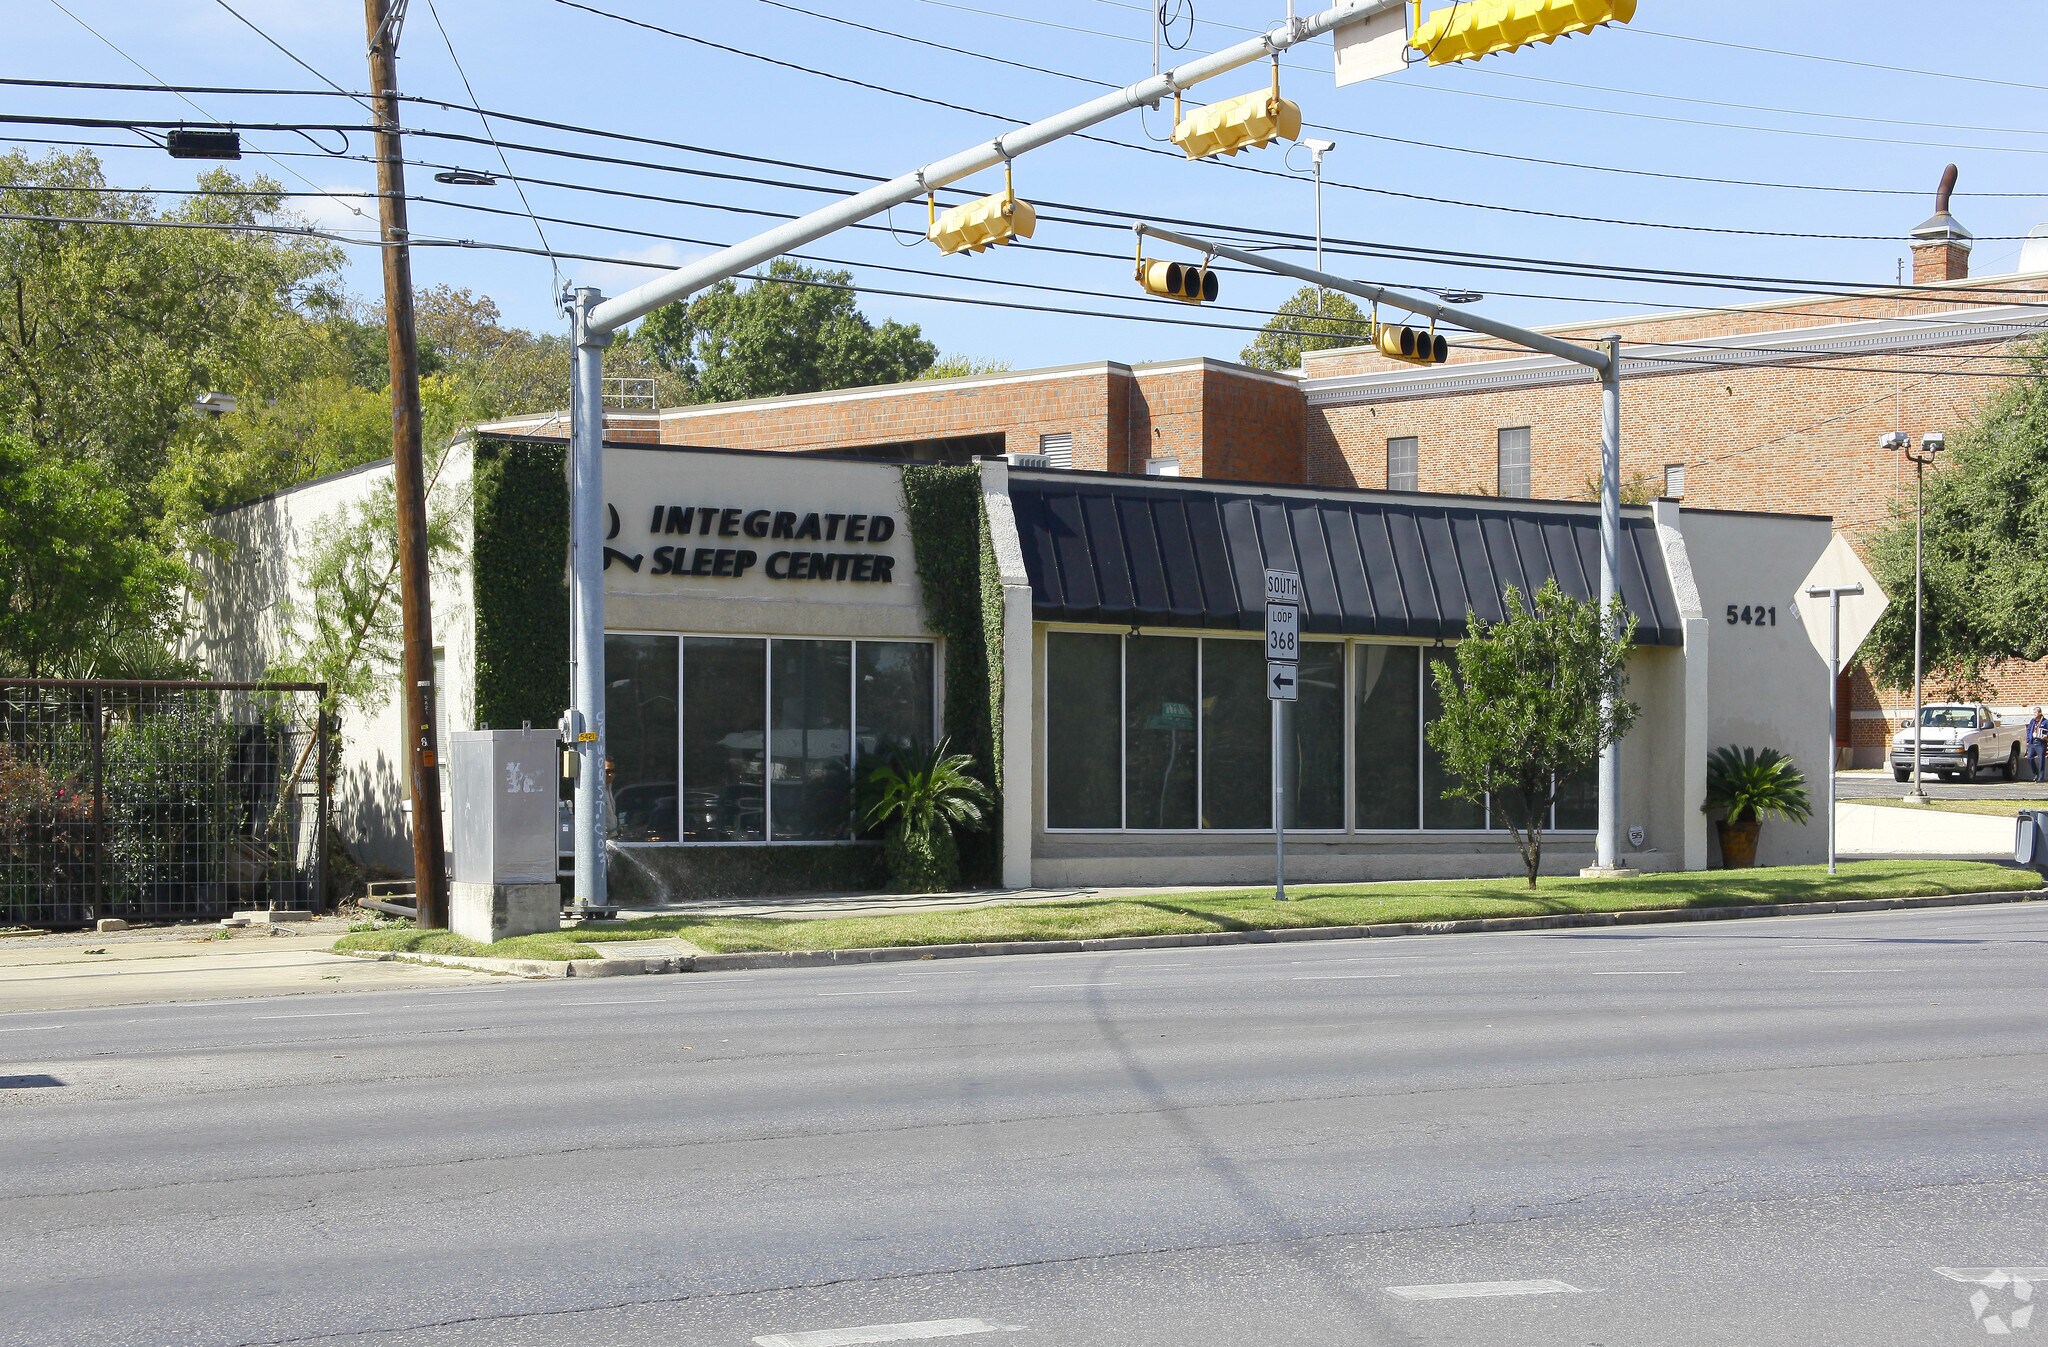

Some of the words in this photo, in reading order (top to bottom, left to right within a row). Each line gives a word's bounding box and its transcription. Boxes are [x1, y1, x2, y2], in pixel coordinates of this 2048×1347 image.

[650, 505, 895, 542] INTEGRATED
[651, 546, 757, 578] SLEEP
[765, 550, 896, 583] CENTER
[1268, 576, 1298, 595] SOUTH
[1272, 611, 1293, 623] LOOP
[1726, 604, 1776, 626] 5421
[1270, 630, 1295, 651] 368
